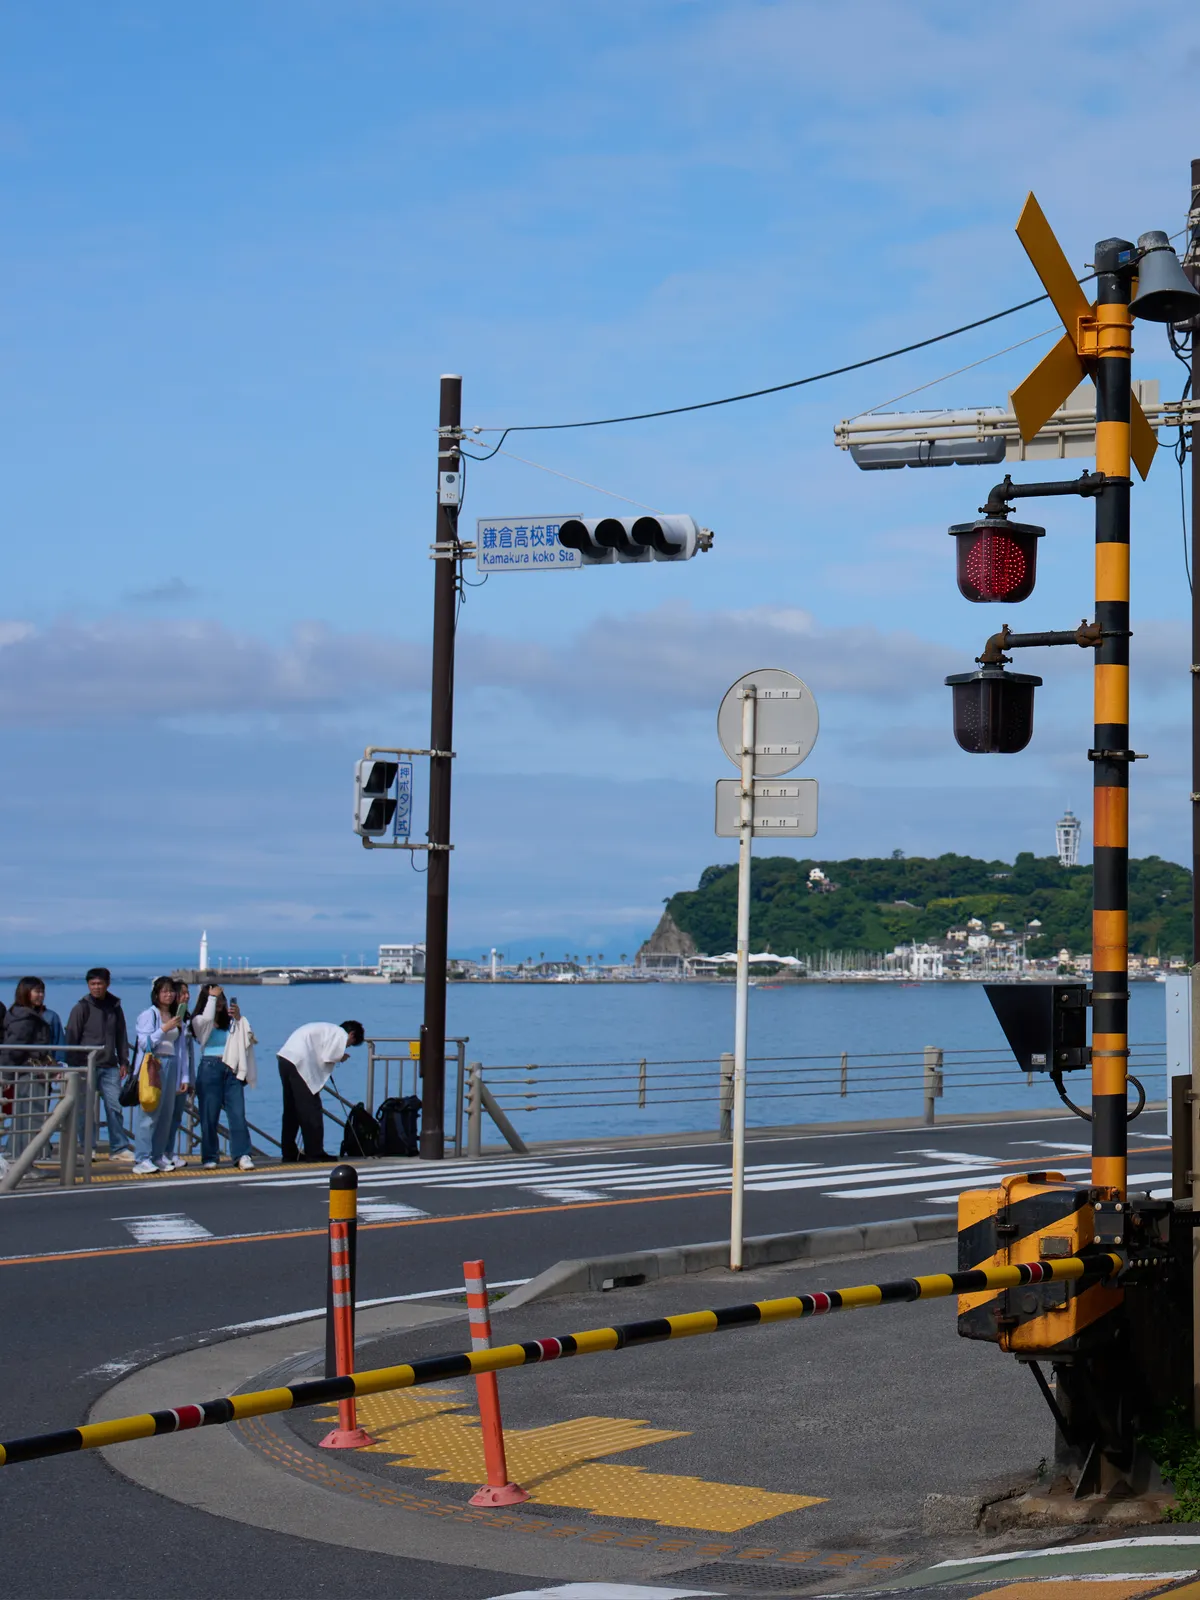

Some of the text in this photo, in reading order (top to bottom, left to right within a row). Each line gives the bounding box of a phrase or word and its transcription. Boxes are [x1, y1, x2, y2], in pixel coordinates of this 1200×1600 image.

[482, 524, 561, 549] 鎌倉高校駅
[483, 549, 577, 565] Kamakura koko Sta.
[398, 767, 410, 832] 押ボタン式
